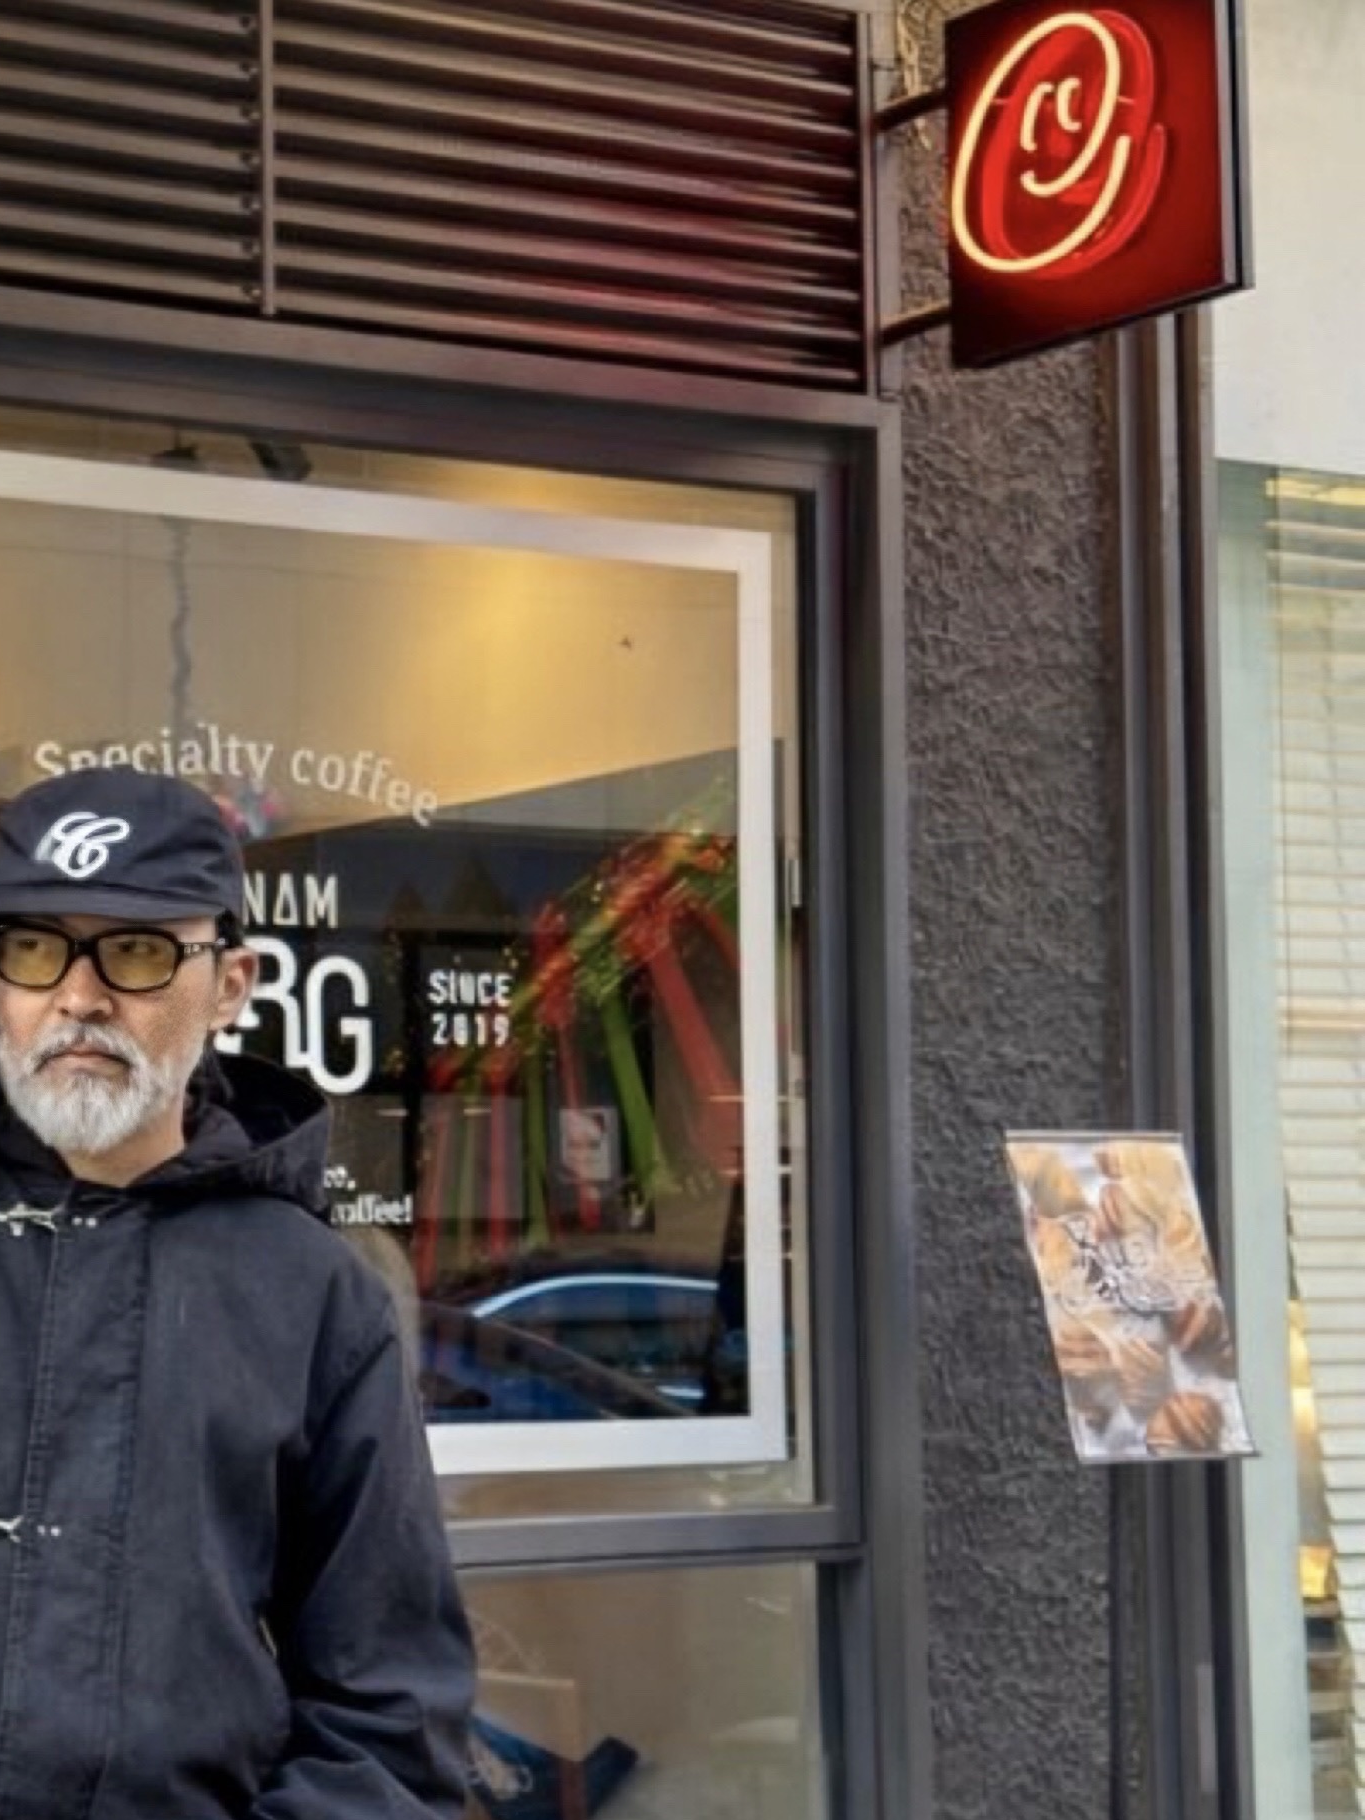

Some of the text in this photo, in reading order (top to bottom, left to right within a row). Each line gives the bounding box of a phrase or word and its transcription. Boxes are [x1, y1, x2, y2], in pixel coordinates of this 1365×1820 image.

[291, 747, 438, 827] coffee
[213, 934, 373, 1094] RG
[428, 968, 513, 1007] SINCE
[431, 1013, 511, 1047] 2019
